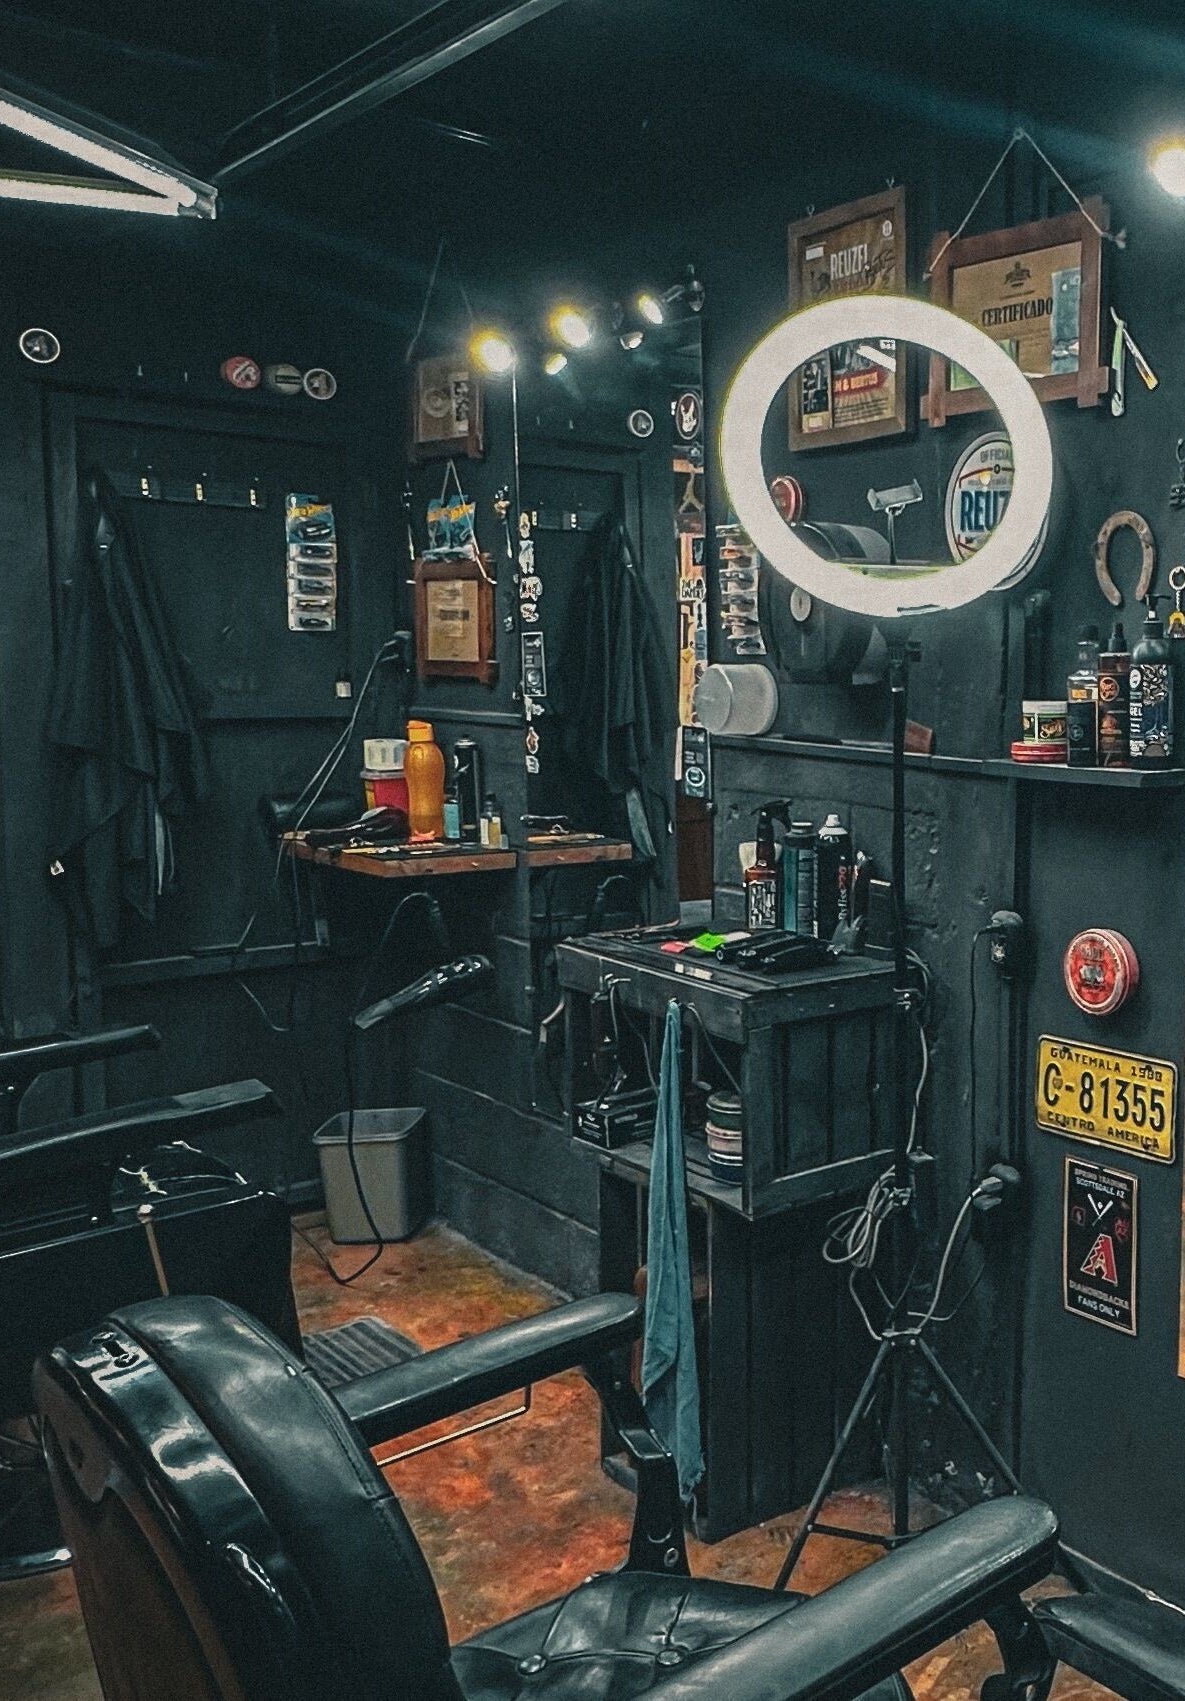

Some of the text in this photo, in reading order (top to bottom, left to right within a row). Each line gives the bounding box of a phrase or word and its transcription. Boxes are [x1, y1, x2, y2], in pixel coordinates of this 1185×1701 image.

[982, 297, 1054, 327] CERTIFICADO
[1049, 1045, 1121, 1075] GUATEMALA
[1043, 1062, 1166, 1133] C-81355
[1047, 1110, 1161, 1151] CENTRO AMERICA
